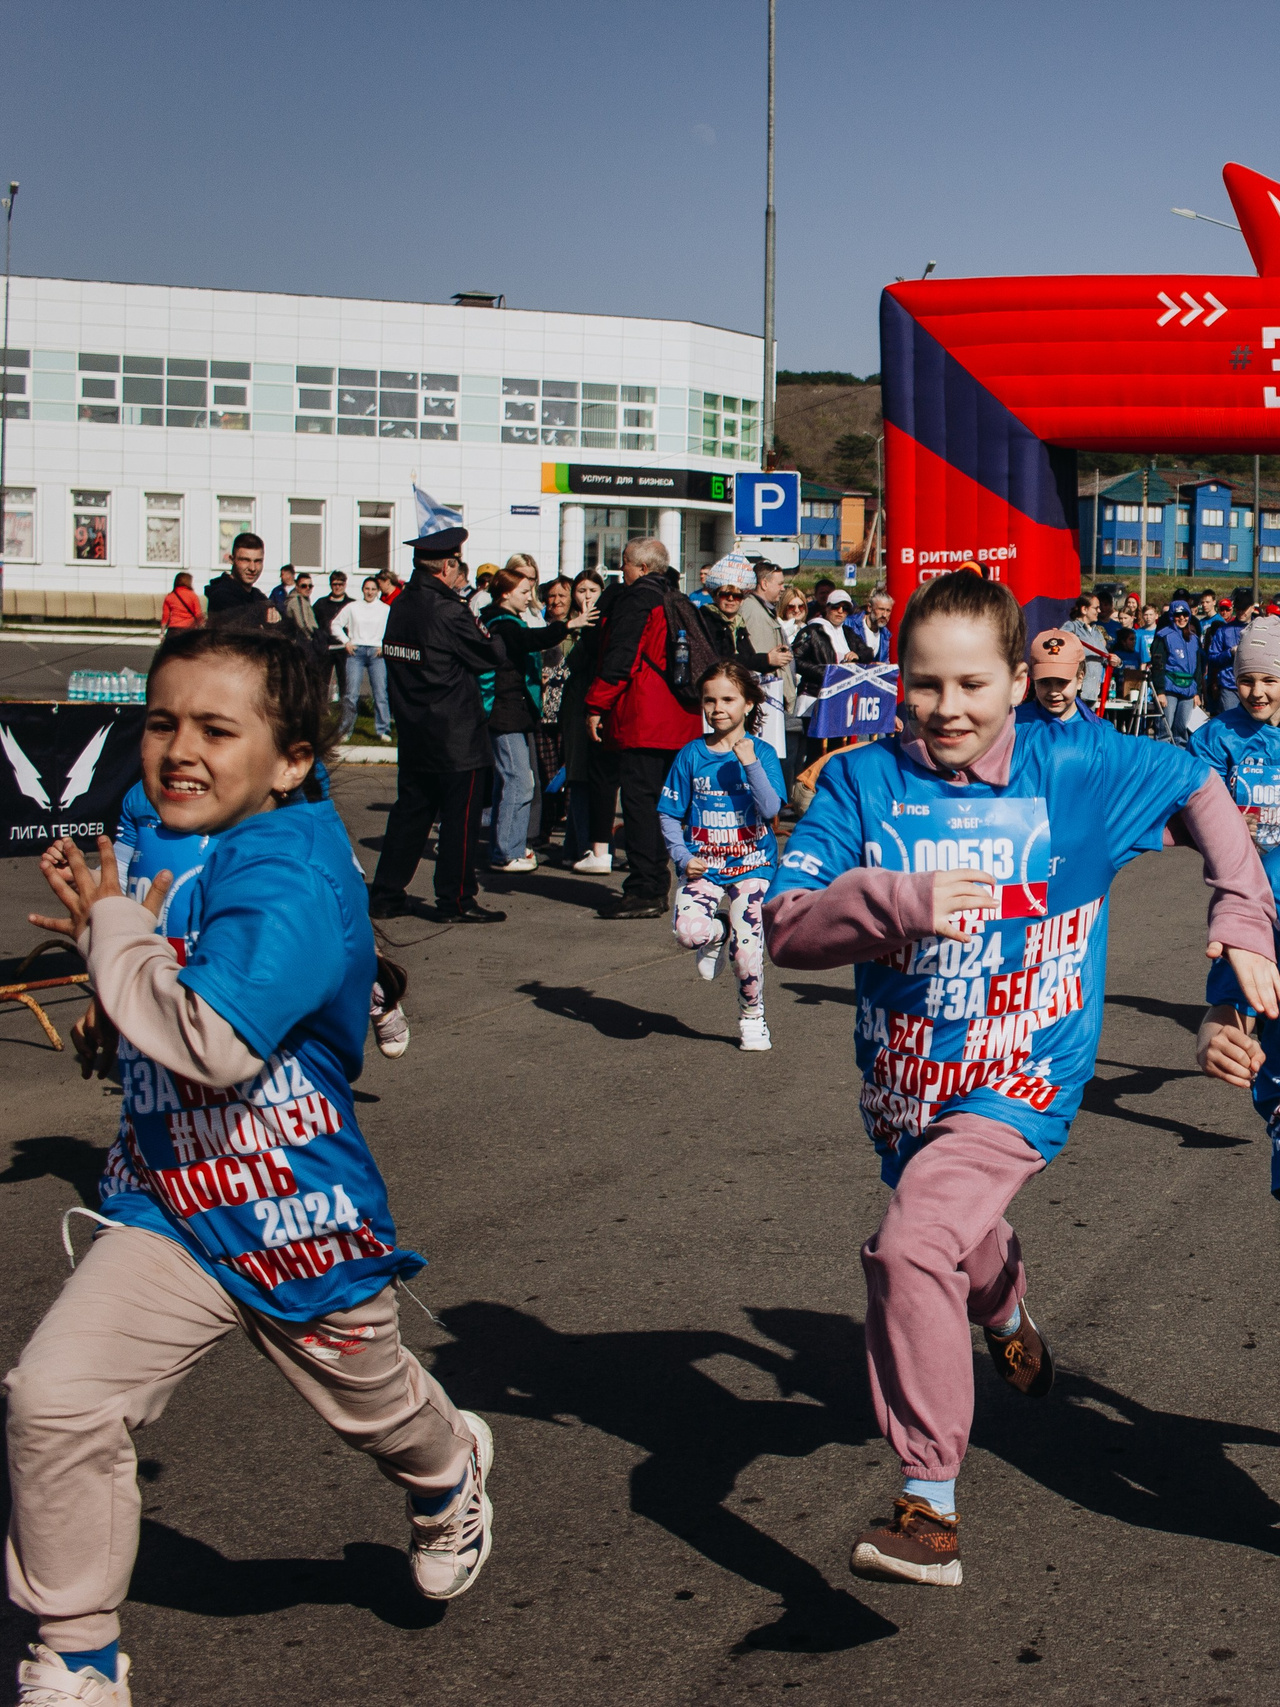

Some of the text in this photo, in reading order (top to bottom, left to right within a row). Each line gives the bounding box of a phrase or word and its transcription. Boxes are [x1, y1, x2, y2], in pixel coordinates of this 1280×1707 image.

[582, 474, 675, 487] УСЛУГИ ДЛЯ БИЗНЕСА
[754, 482, 786, 528] P
[901, 543, 1018, 566] В ритме всей
[384, 644, 421, 661] ПОЛИЦИЯ
[858, 697, 881, 721] ПСБ
[702, 809, 745, 828] 00505
[907, 804, 931, 816] ПСБ
[10, 822, 105, 841] ЛИГА ГЕРОЕВ
[708, 828, 739, 844] 500М
[783, 850, 824, 876] СБ
[915, 838, 1014, 881] 00513
[254, 1184, 359, 1248] 2024
